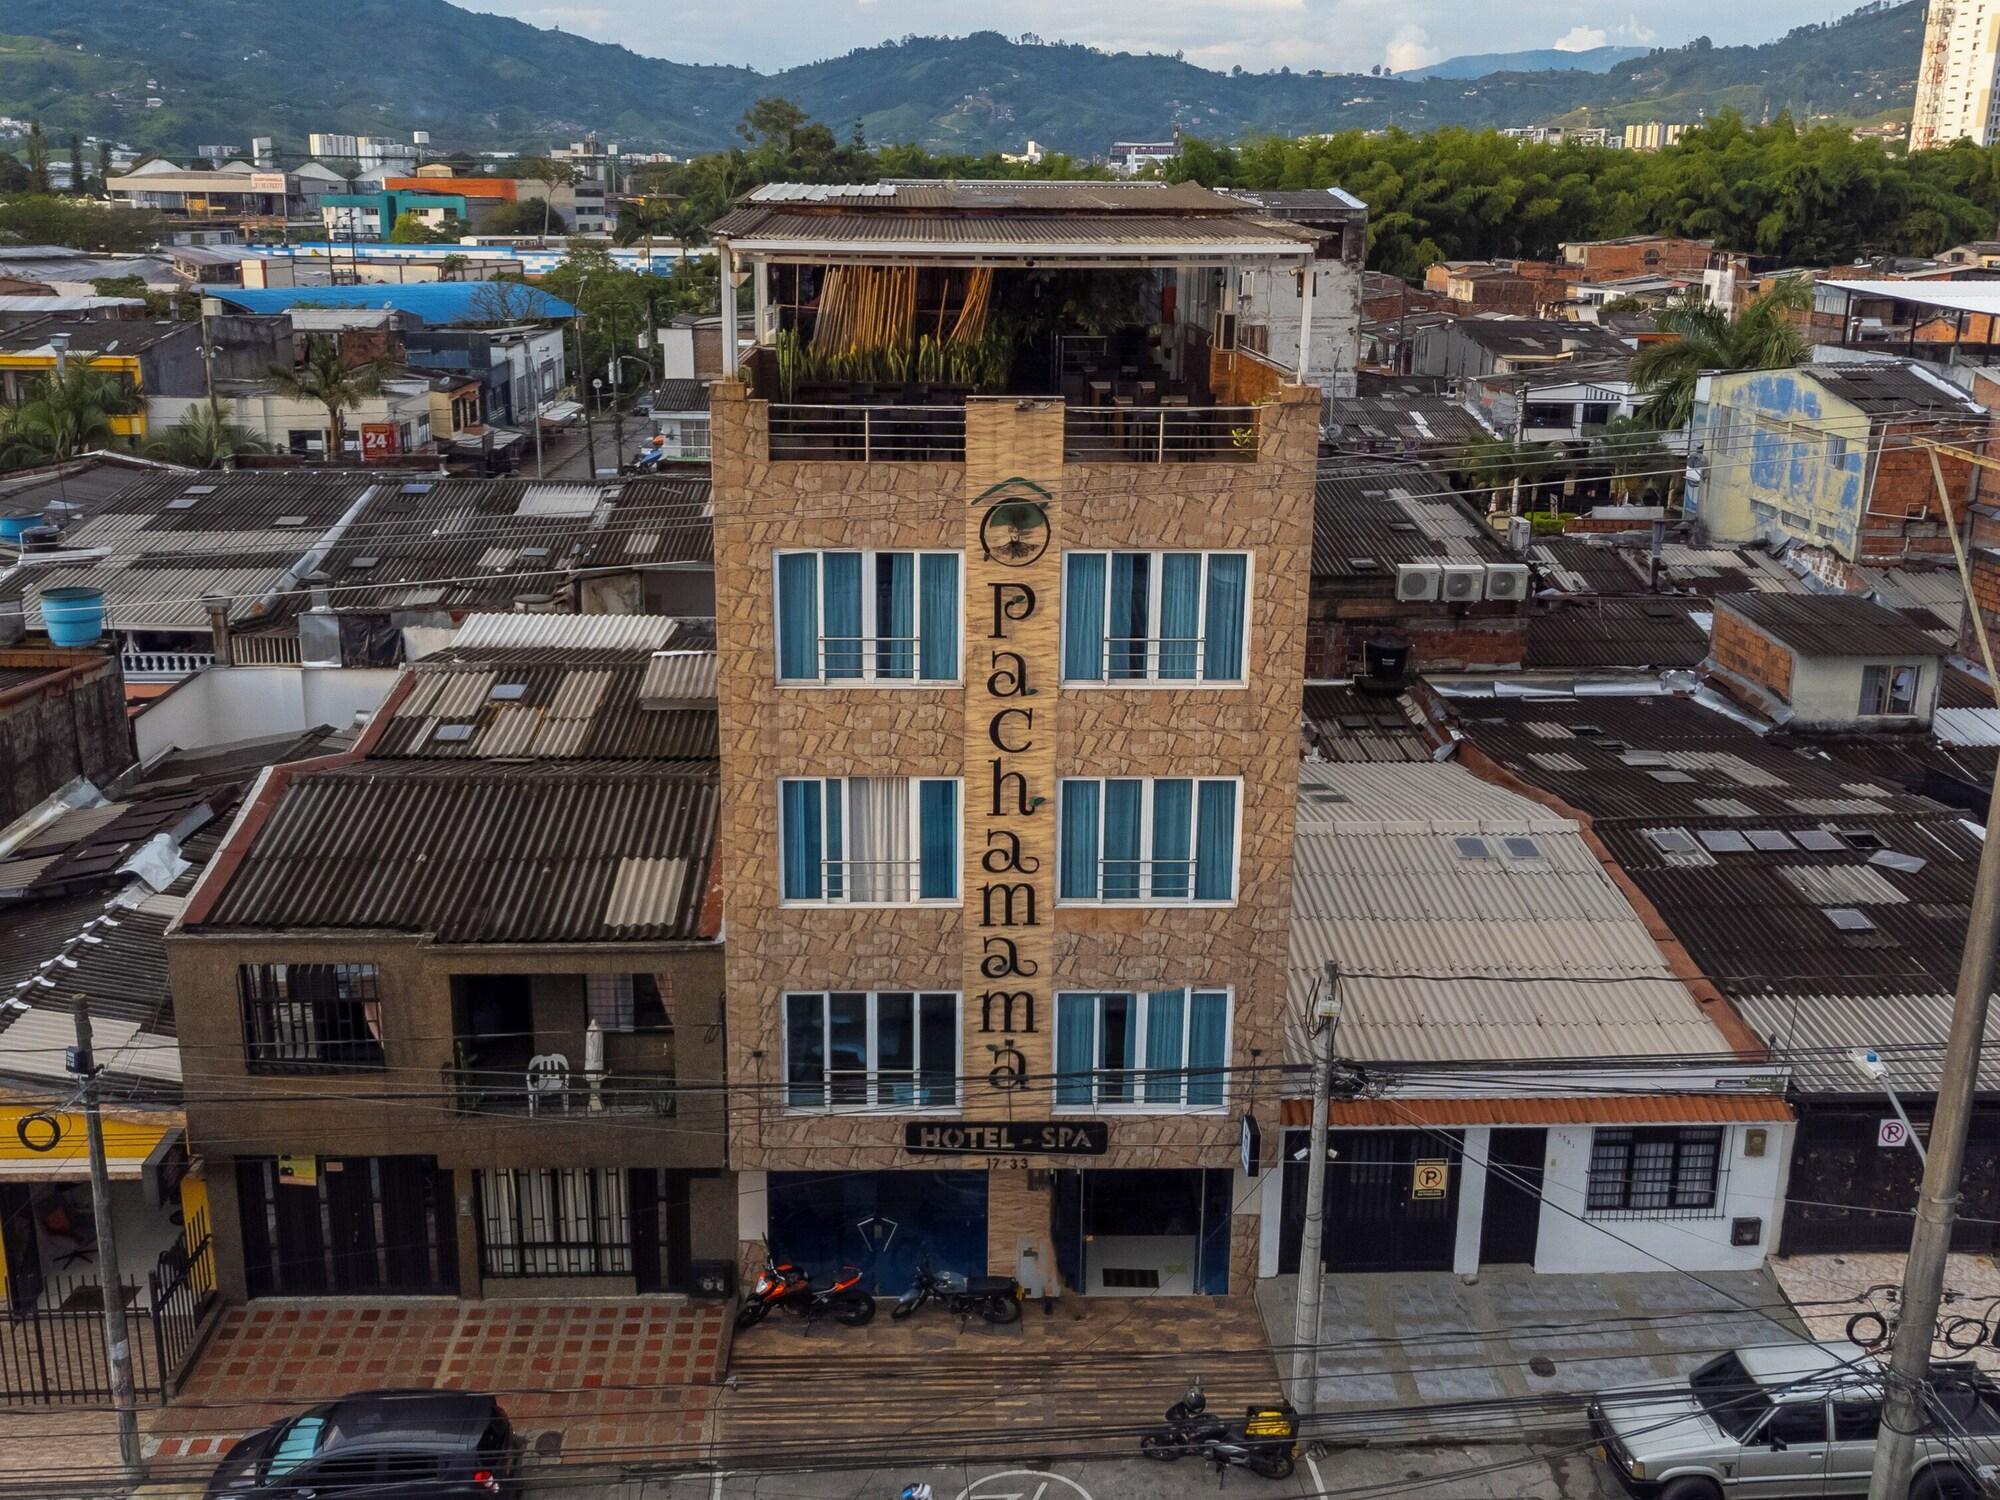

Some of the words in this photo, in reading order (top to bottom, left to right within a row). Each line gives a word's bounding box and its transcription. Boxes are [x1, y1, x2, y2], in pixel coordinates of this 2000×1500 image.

[366, 432, 387, 448] 24
[977, 581, 1042, 1090] Pachamama
[920, 1127, 1015, 1148] HOTEL
[1041, 1127, 1092, 1148] SPA
